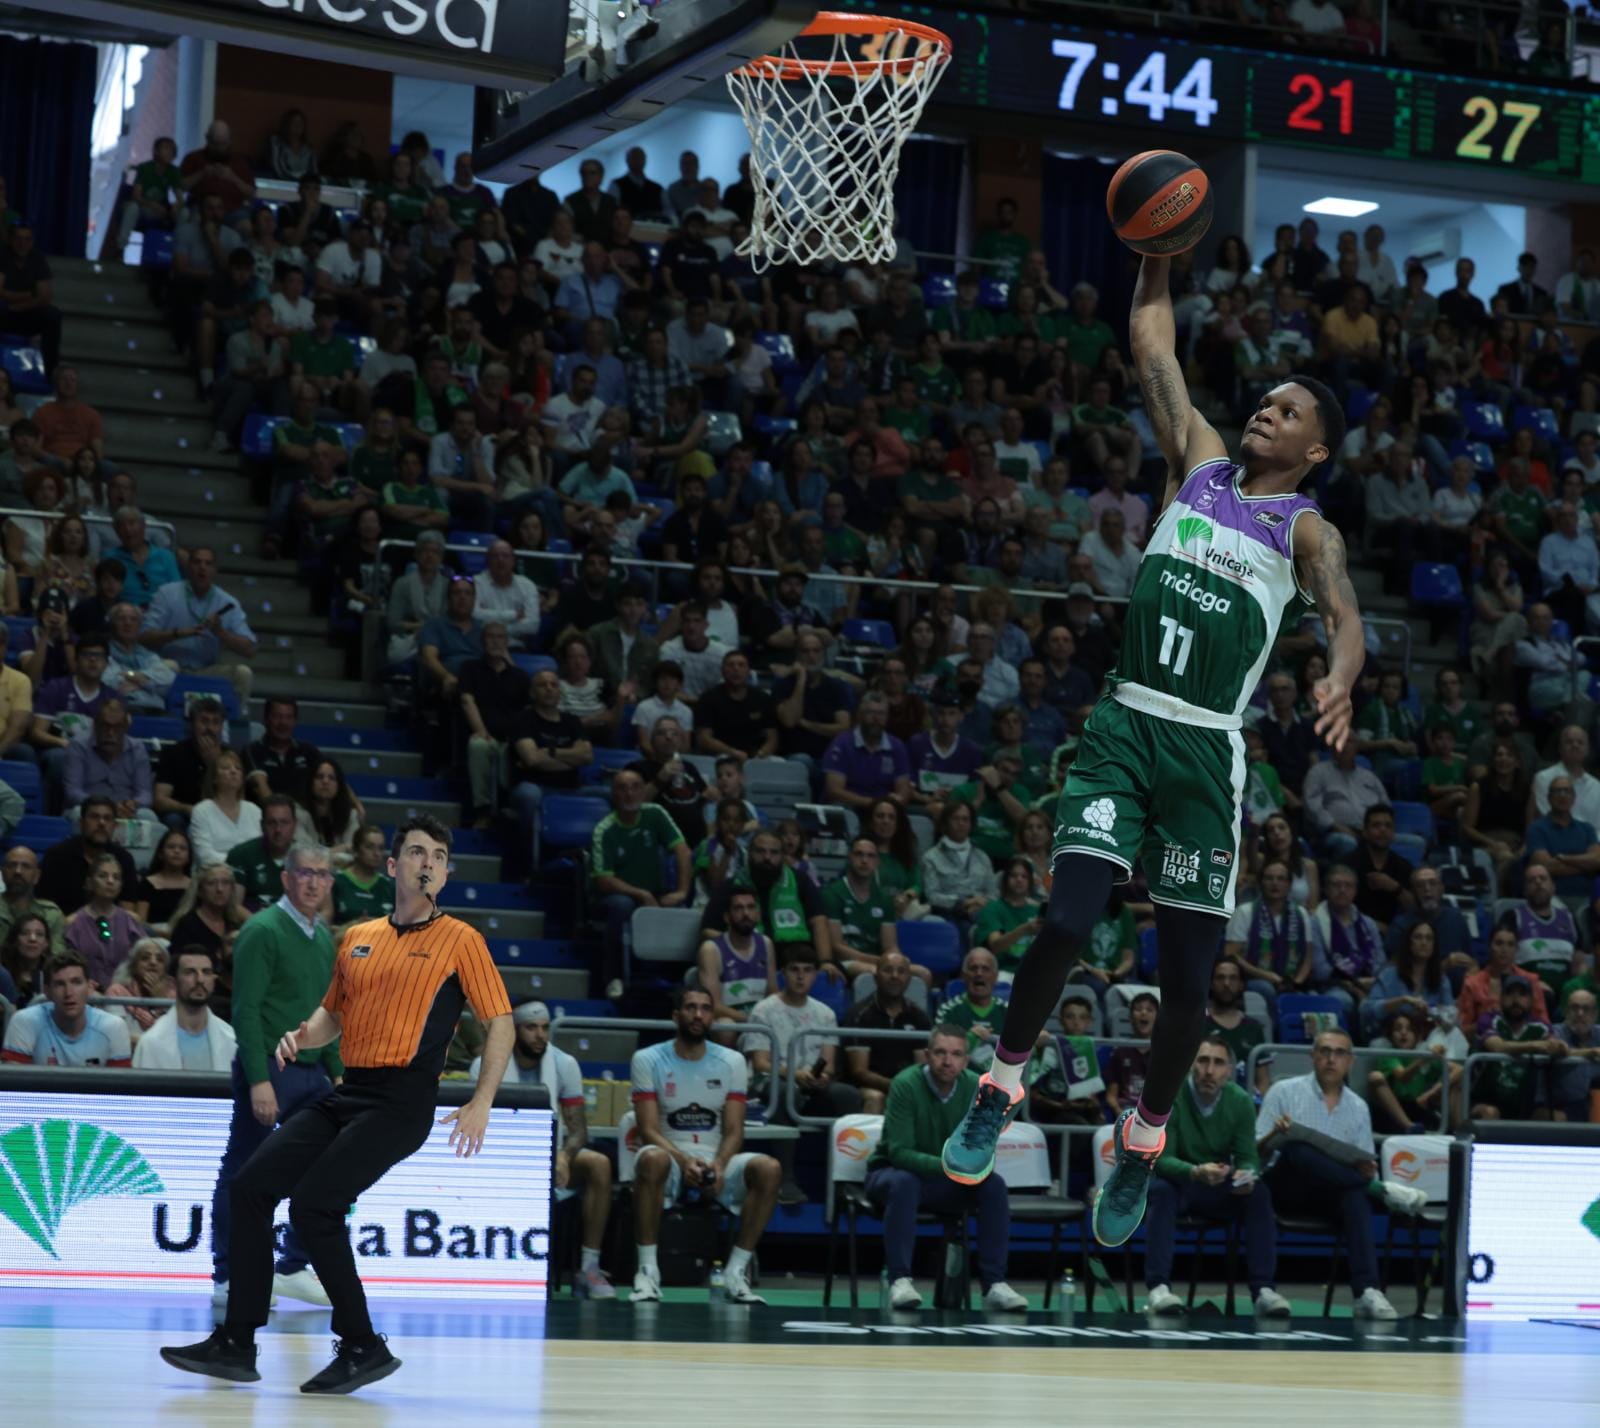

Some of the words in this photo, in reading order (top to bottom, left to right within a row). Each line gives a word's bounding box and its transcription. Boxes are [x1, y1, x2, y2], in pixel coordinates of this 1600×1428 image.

[1052, 39, 1219, 127] 7:44
[1287, 74, 1354, 135] 21
[1456, 97, 1542, 162] 27
[1151, 186, 1201, 229] LEGACY
[1205, 547, 1255, 578] Unicaja
[1159, 615, 1194, 676] 11
[1213, 855, 1228, 864] acb
